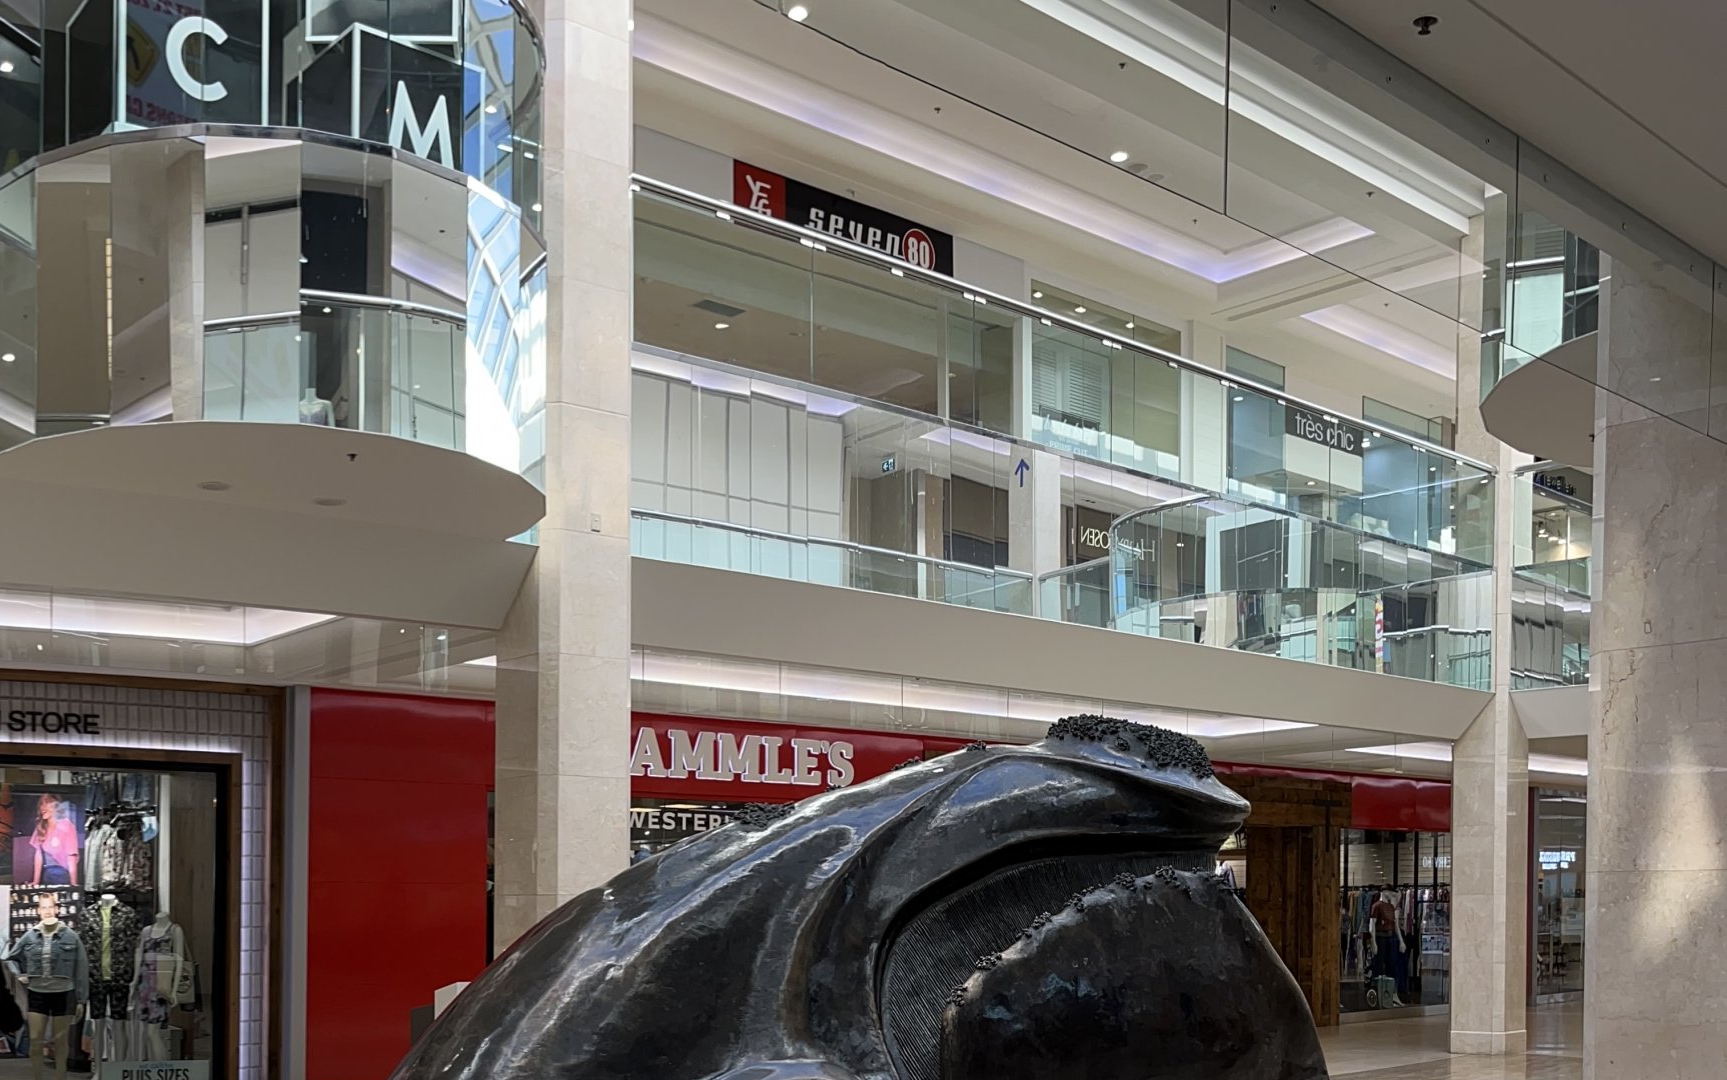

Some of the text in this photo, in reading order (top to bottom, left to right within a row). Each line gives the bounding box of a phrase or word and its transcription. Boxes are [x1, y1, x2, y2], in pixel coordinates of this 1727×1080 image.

[165, 16, 228, 102] C
[389, 80, 454, 170] M
[907, 236, 930, 271] 80
[1295, 412, 1354, 451] très chic
[8, 710, 100, 735] STORE
[630, 810, 732, 832] WESTER
